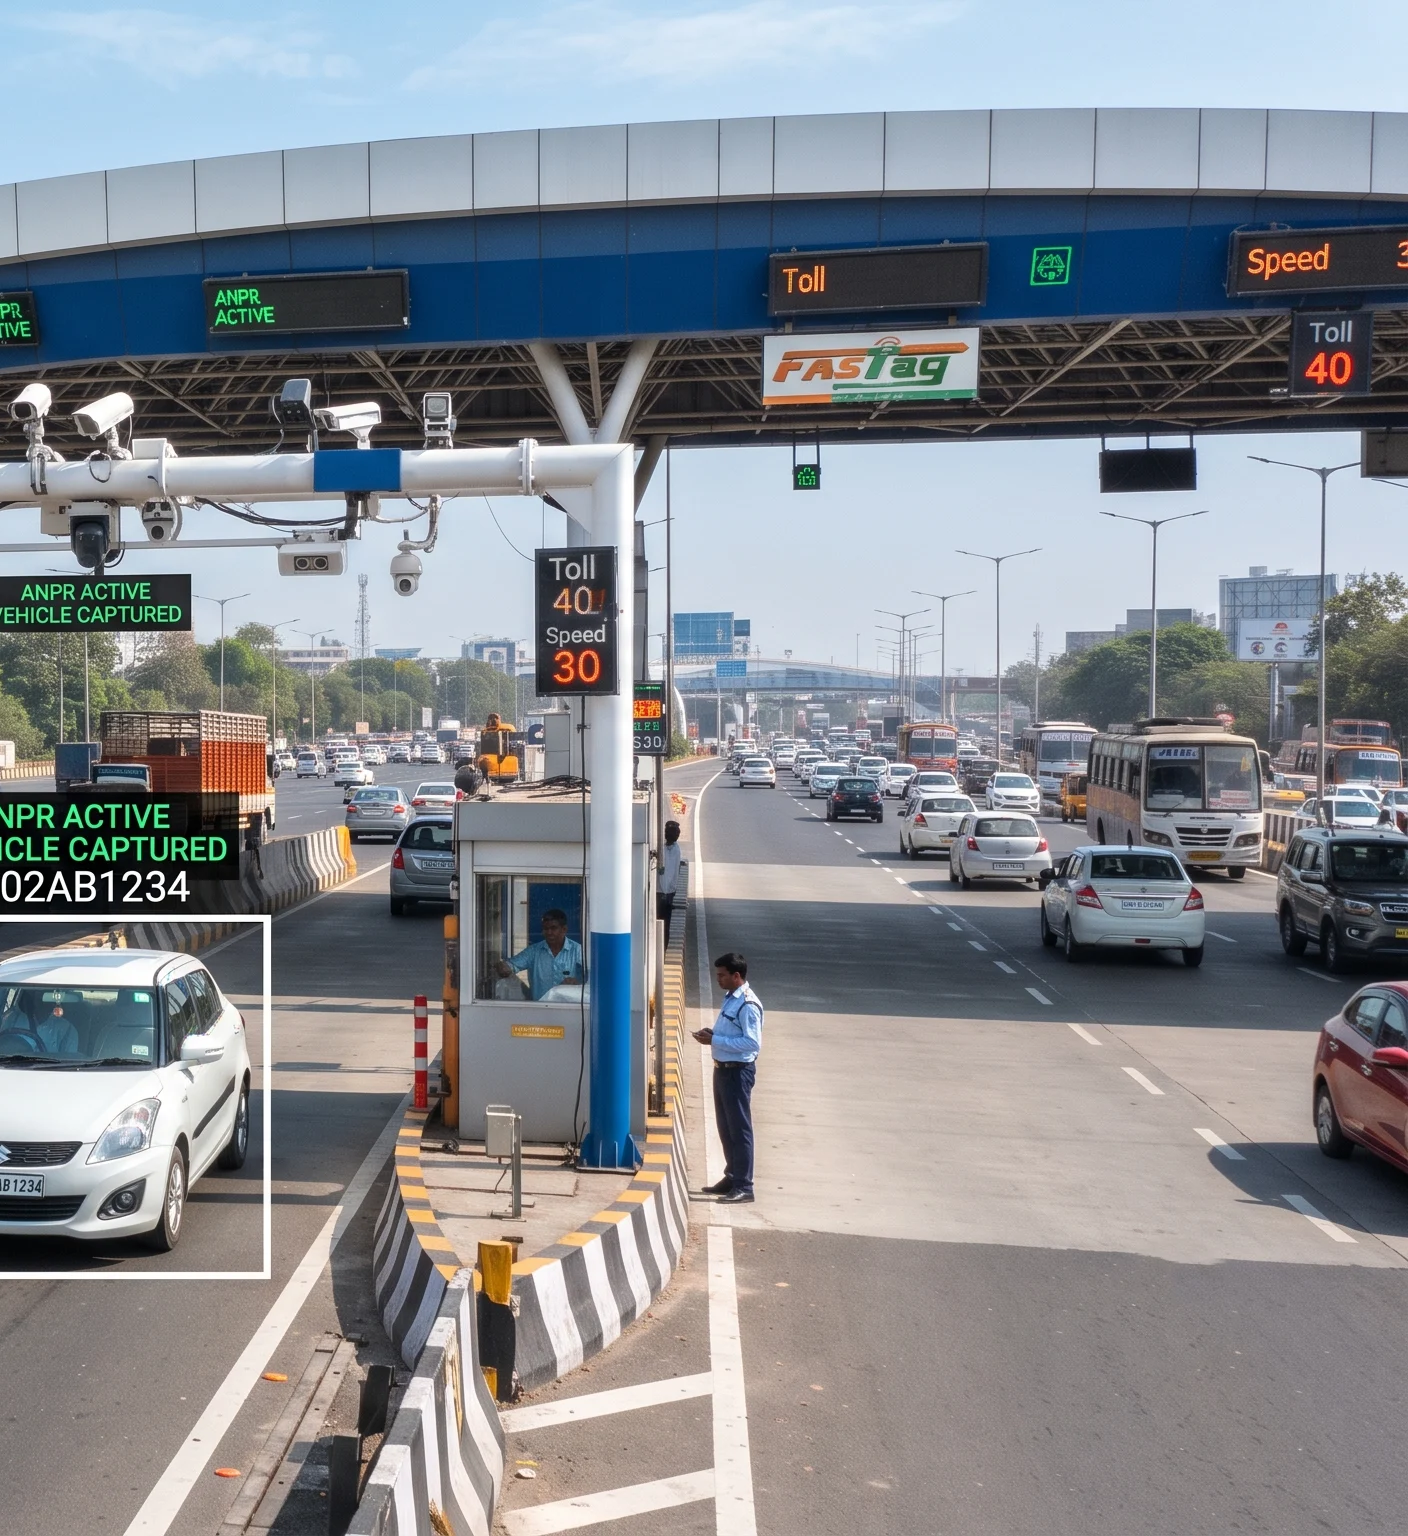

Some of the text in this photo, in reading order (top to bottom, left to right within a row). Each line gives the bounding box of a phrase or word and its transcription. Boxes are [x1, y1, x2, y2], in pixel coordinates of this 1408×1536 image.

[1247, 243, 1330, 281] Speed
[782, 266, 826, 293] Toll
[214, 288, 261, 307] ANPR
[214, 306, 275, 326] ACTIVE
[1309, 320, 1353, 343] Toll
[772, 345, 954, 390] FASTag
[1304, 351, 1353, 386] 40
[548, 554, 596, 581] Toll
[21, 582, 151, 601] ANPR ACTIVE
[77, 605, 182, 625] CAPTURED
[546, 623, 607, 648] Speed
[553, 649, 601, 684] 30
[13, 1179, 43, 1193] 1234
